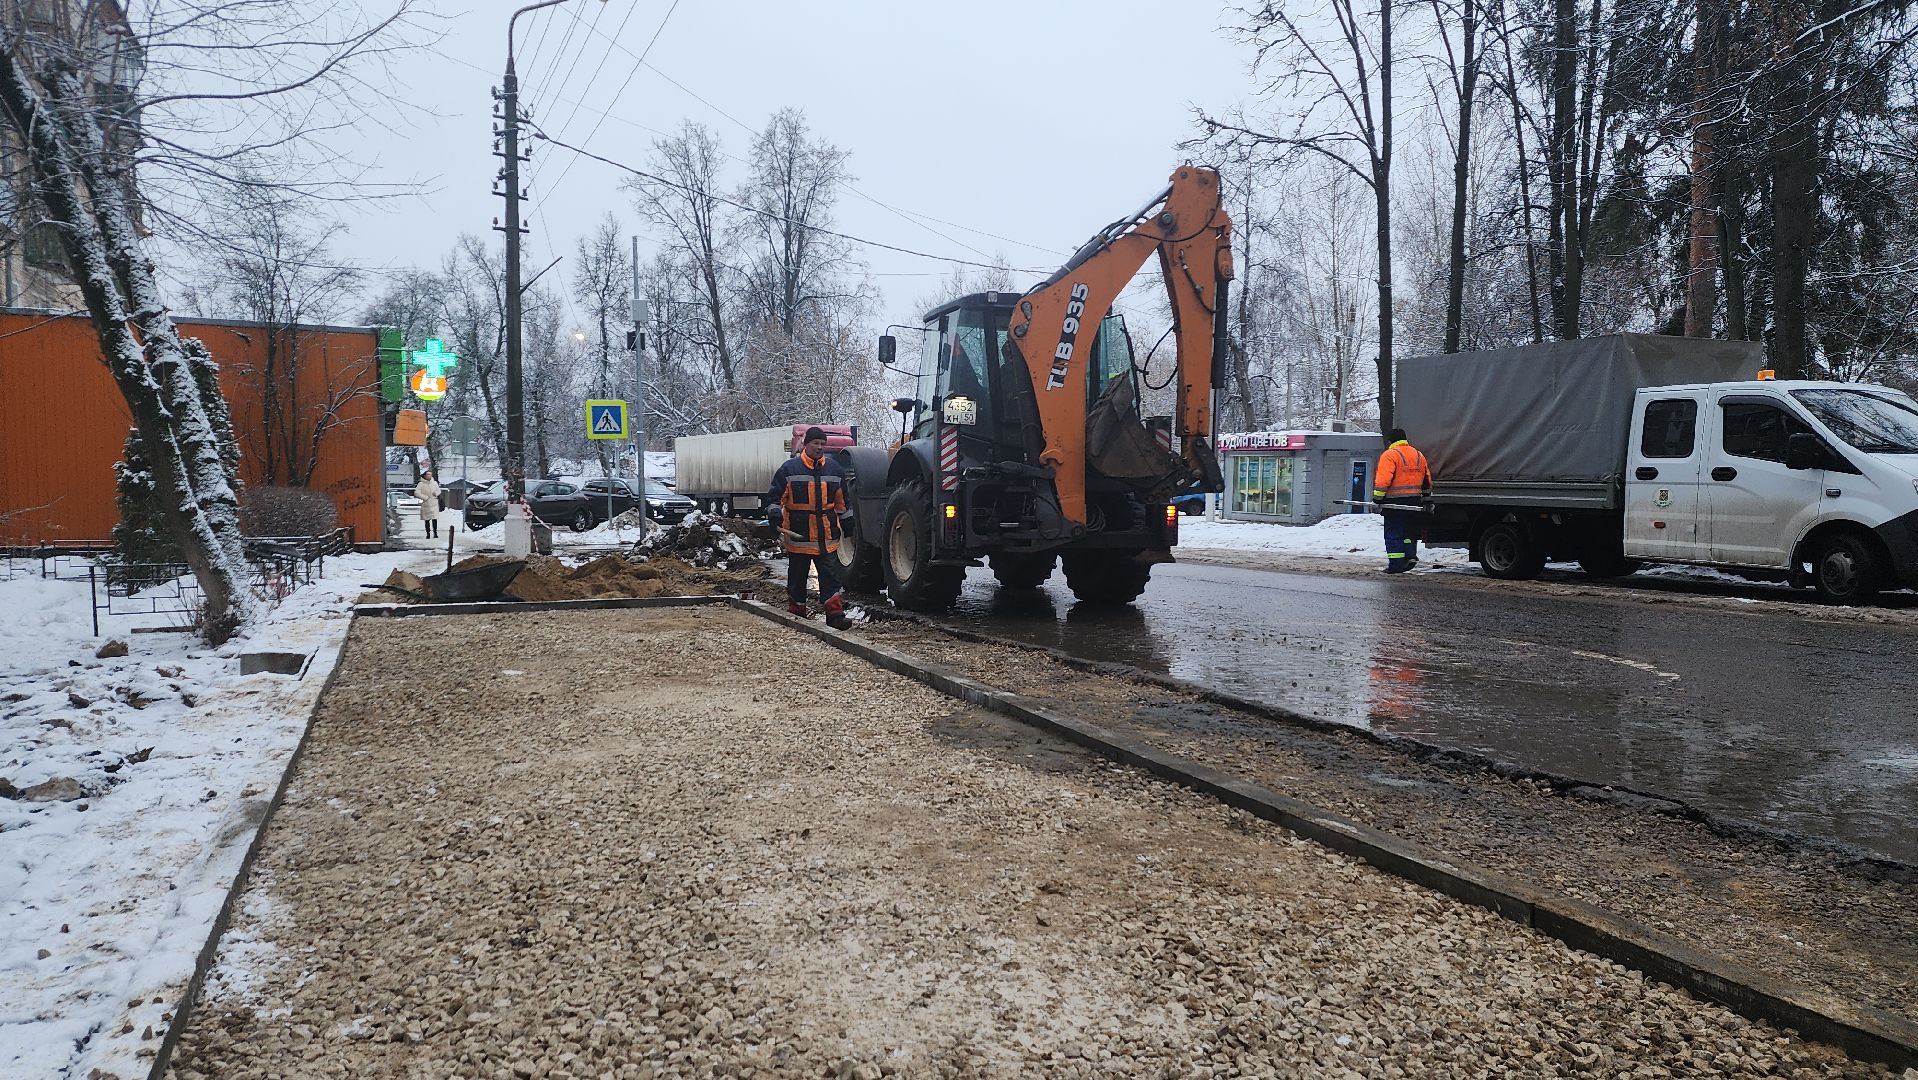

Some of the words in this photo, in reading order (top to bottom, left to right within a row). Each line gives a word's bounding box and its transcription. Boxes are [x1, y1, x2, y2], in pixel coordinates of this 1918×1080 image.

[1046, 341, 1074, 391] TLB
[1062, 282, 1089, 334] 935
[948, 401, 973, 411] 4352
[947, 415, 959, 423] ХН
[964, 413, 974, 422] 50
[1218, 434, 1248, 450] ТУДИЯ
[1250, 434, 1288, 449] ЦВЕТОВ
